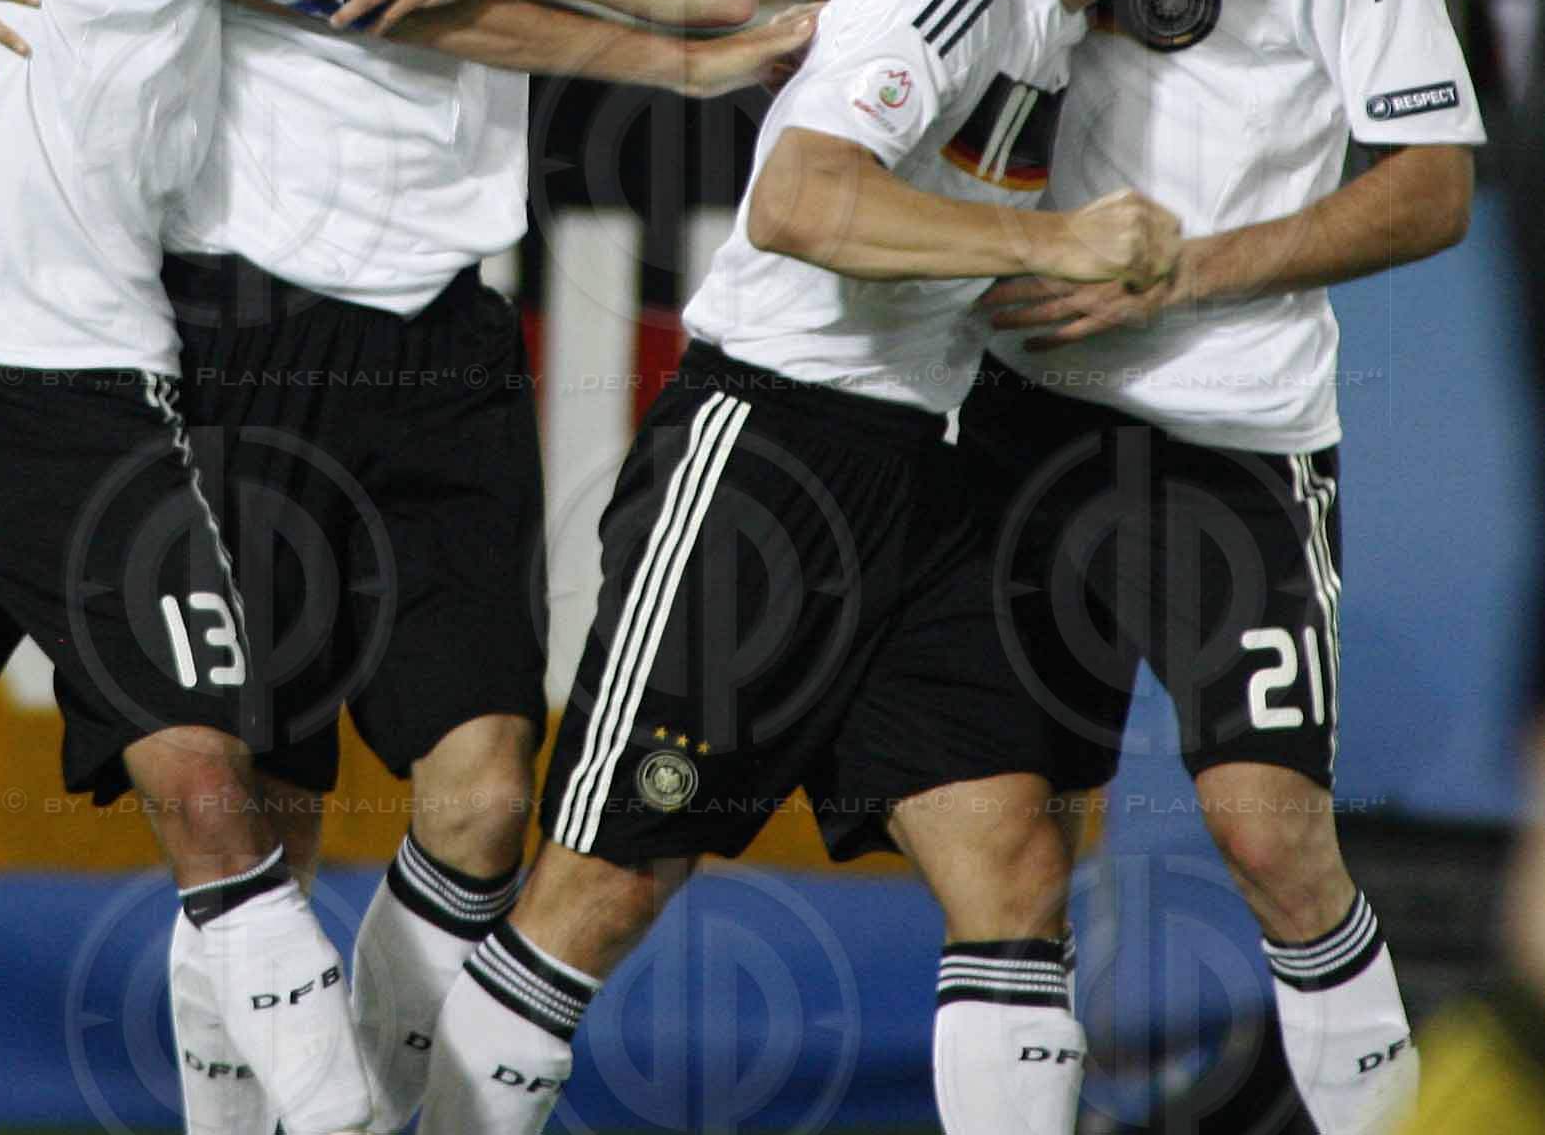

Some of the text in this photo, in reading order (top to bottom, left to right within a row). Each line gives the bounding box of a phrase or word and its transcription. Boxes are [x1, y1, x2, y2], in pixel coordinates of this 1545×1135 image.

[1391, 87, 1456, 111] RESPECT
[161, 592, 246, 689] 13
[1241, 626, 1325, 729] 21
[251, 965, 340, 1011] DFB
[1018, 1046, 1081, 1064] DF
[1358, 1038, 1409, 1073] DF
[491, 1064, 561, 1093] DF
